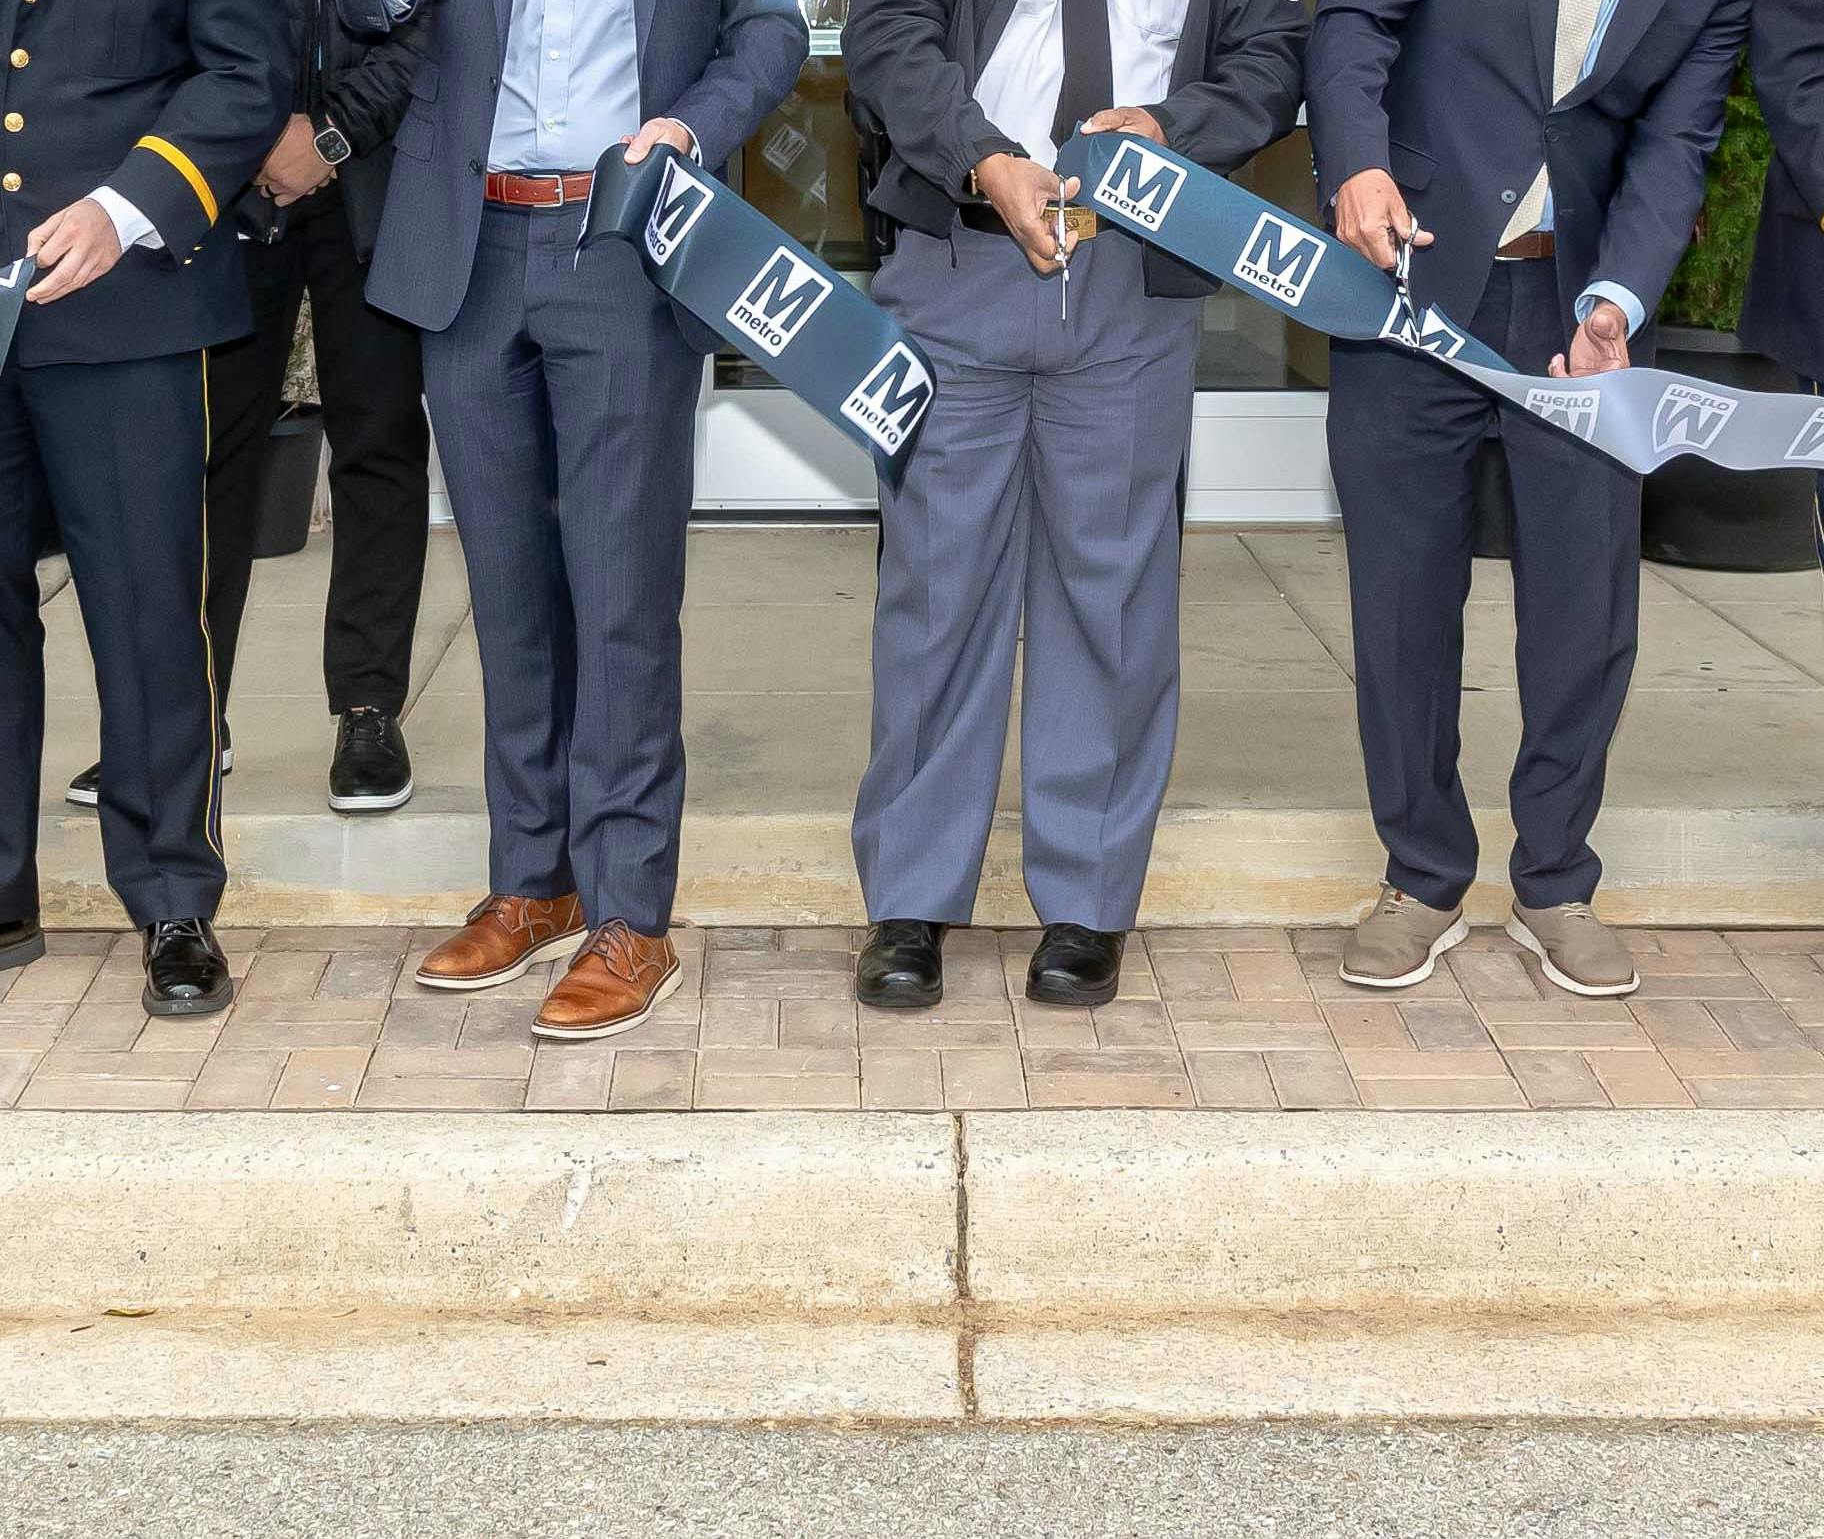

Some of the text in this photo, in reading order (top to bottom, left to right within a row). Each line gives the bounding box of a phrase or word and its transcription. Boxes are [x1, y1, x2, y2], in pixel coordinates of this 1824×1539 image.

[1100, 188, 1156, 225] metro
[1106, 145, 1179, 214] M
[1240, 262, 1297, 300] metro
[1248, 219, 1318, 288] M
[746, 254, 826, 333] M
[734, 304, 782, 348] metro
[850, 395, 899, 446] metro
[864, 357, 931, 434] M
